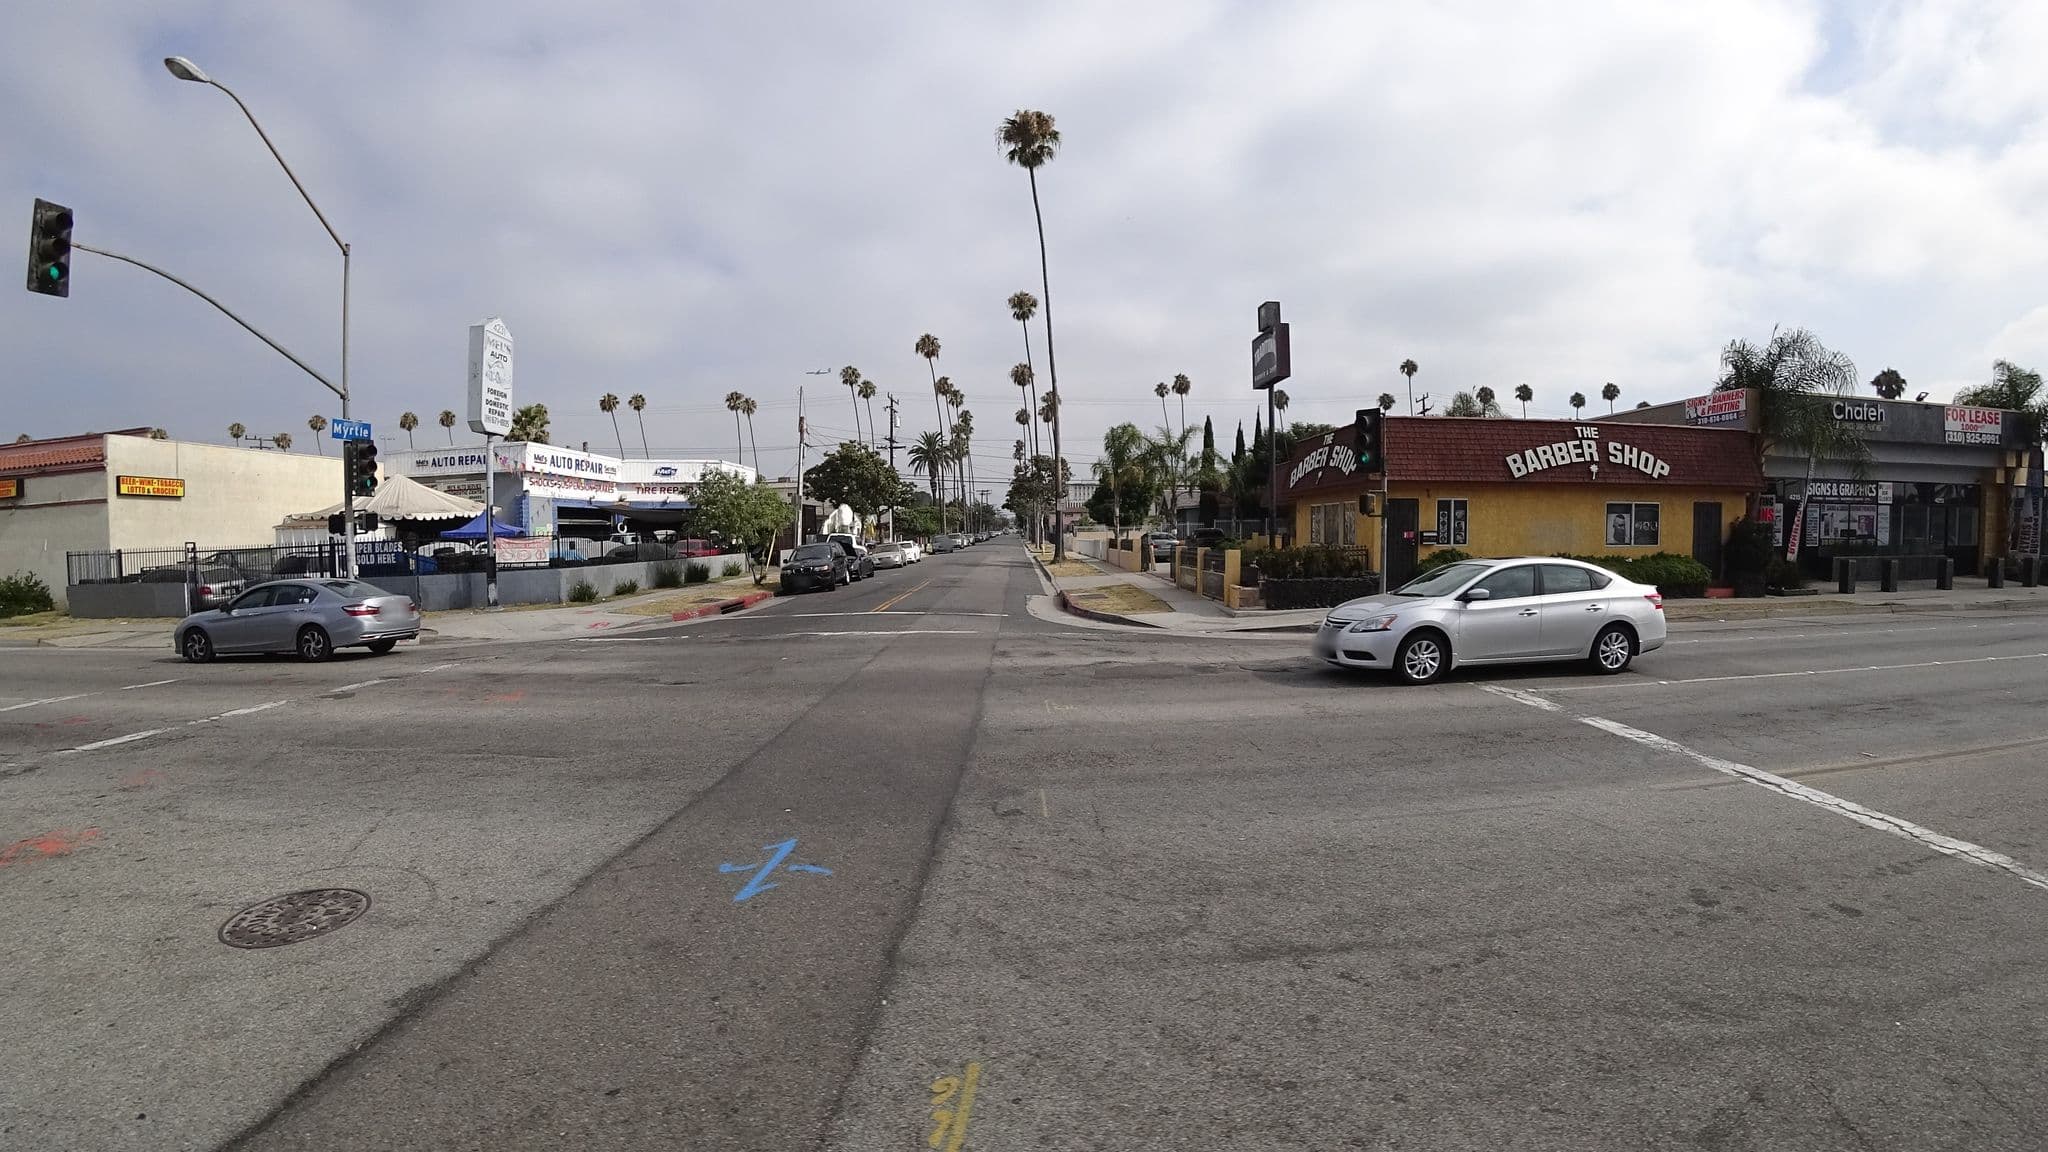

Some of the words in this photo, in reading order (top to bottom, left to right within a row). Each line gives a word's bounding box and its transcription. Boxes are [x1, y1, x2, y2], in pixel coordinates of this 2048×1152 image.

[490, 351, 508, 363] AUTO
[487, 387, 507, 399] FOREIGN
[1686, 396, 1708, 409] SIGNS
[1712, 389, 1745, 404] BANNERS
[485, 398, 509, 411] DOMESTIC
[1707, 400, 1740, 415] PRINTING
[1832, 401, 1886, 421] Chafeh
[488, 407, 505, 418] REPAIR
[1945, 407, 1966, 422] FOR
[1968, 409, 2000, 426] LEASE
[333, 422, 369, 439] Myrtle
[1574, 426, 1600, 439] THE
[1323, 432, 1335, 446] THE
[1945, 431, 1965, 445] (310)
[431, 456, 456, 468] AUTO
[458, 454, 487, 466] REPAI
[549, 455, 573, 470] AUTO
[574, 459, 604, 475] REPAIR
[1505, 439, 1600, 479] BARBER
[1608, 441, 1671, 480] SHOP
[1289, 446, 1330, 489] BARBER
[128, 486, 146, 494] LOTTO
[152, 487, 178, 496] GROCERY
[636, 486, 657, 495] TIRE
[1807, 482, 1831, 496] SIGNS
[1831, 482, 1839, 496] &
[1839, 482, 1877, 497] GRAPHICS
[375, 541, 403, 553] BLADES
[356, 554, 375, 565] SOLD
[377, 553, 397, 564] HERE
